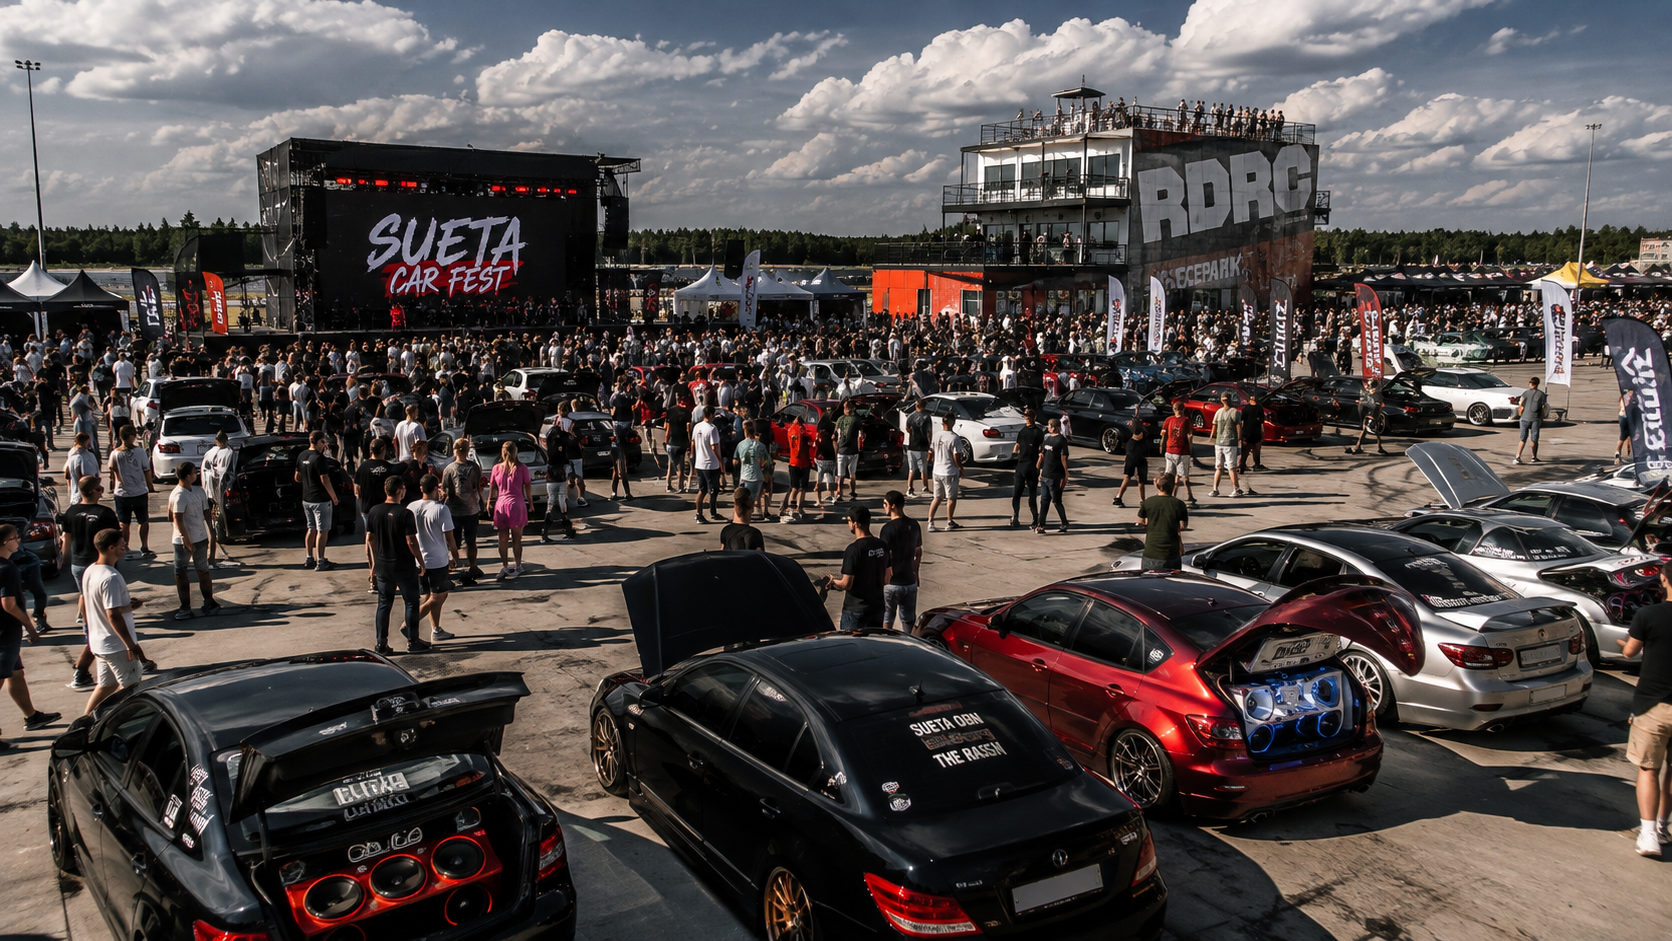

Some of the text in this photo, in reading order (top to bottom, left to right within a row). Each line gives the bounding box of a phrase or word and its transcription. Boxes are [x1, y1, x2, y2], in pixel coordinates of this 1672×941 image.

[366, 213, 528, 276] SUETA
[390, 265, 511, 295] CAR FEST
[909, 717, 956, 737] SUETA
[932, 750, 965, 768] THE
